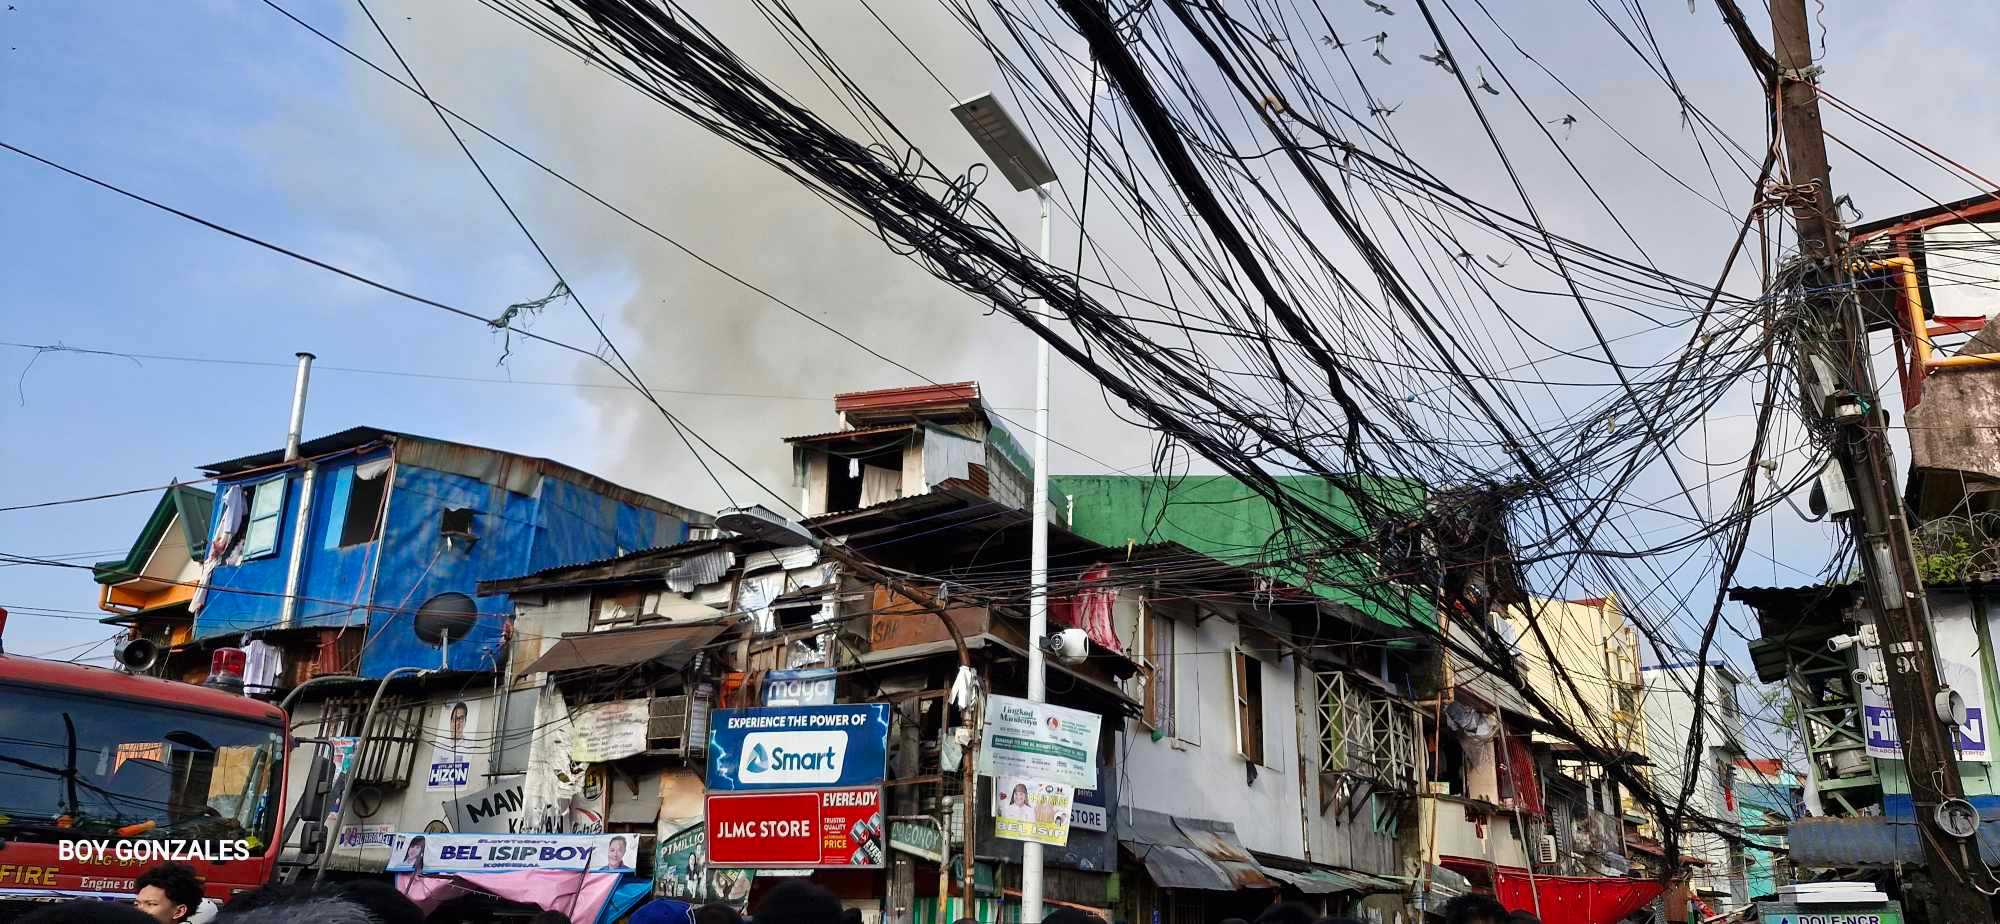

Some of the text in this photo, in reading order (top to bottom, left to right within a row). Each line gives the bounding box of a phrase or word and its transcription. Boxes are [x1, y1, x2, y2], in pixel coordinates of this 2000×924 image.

[769, 681, 829, 699] maya
[728, 714, 867, 728] EXPERIENCE THE POWER OF
[771, 746, 836, 771] Smart
[430, 767, 468, 783] HIZON
[823, 791, 877, 806] EVEREADY
[717, 821, 757, 838] JLMC
[760, 820, 811, 837] STORE
[824, 839, 847, 848] PRICE
[440, 846, 595, 861] BEL ISIP BOY
[0, 864, 60, 886] FIRE
[80, 877, 121, 891] Engine
